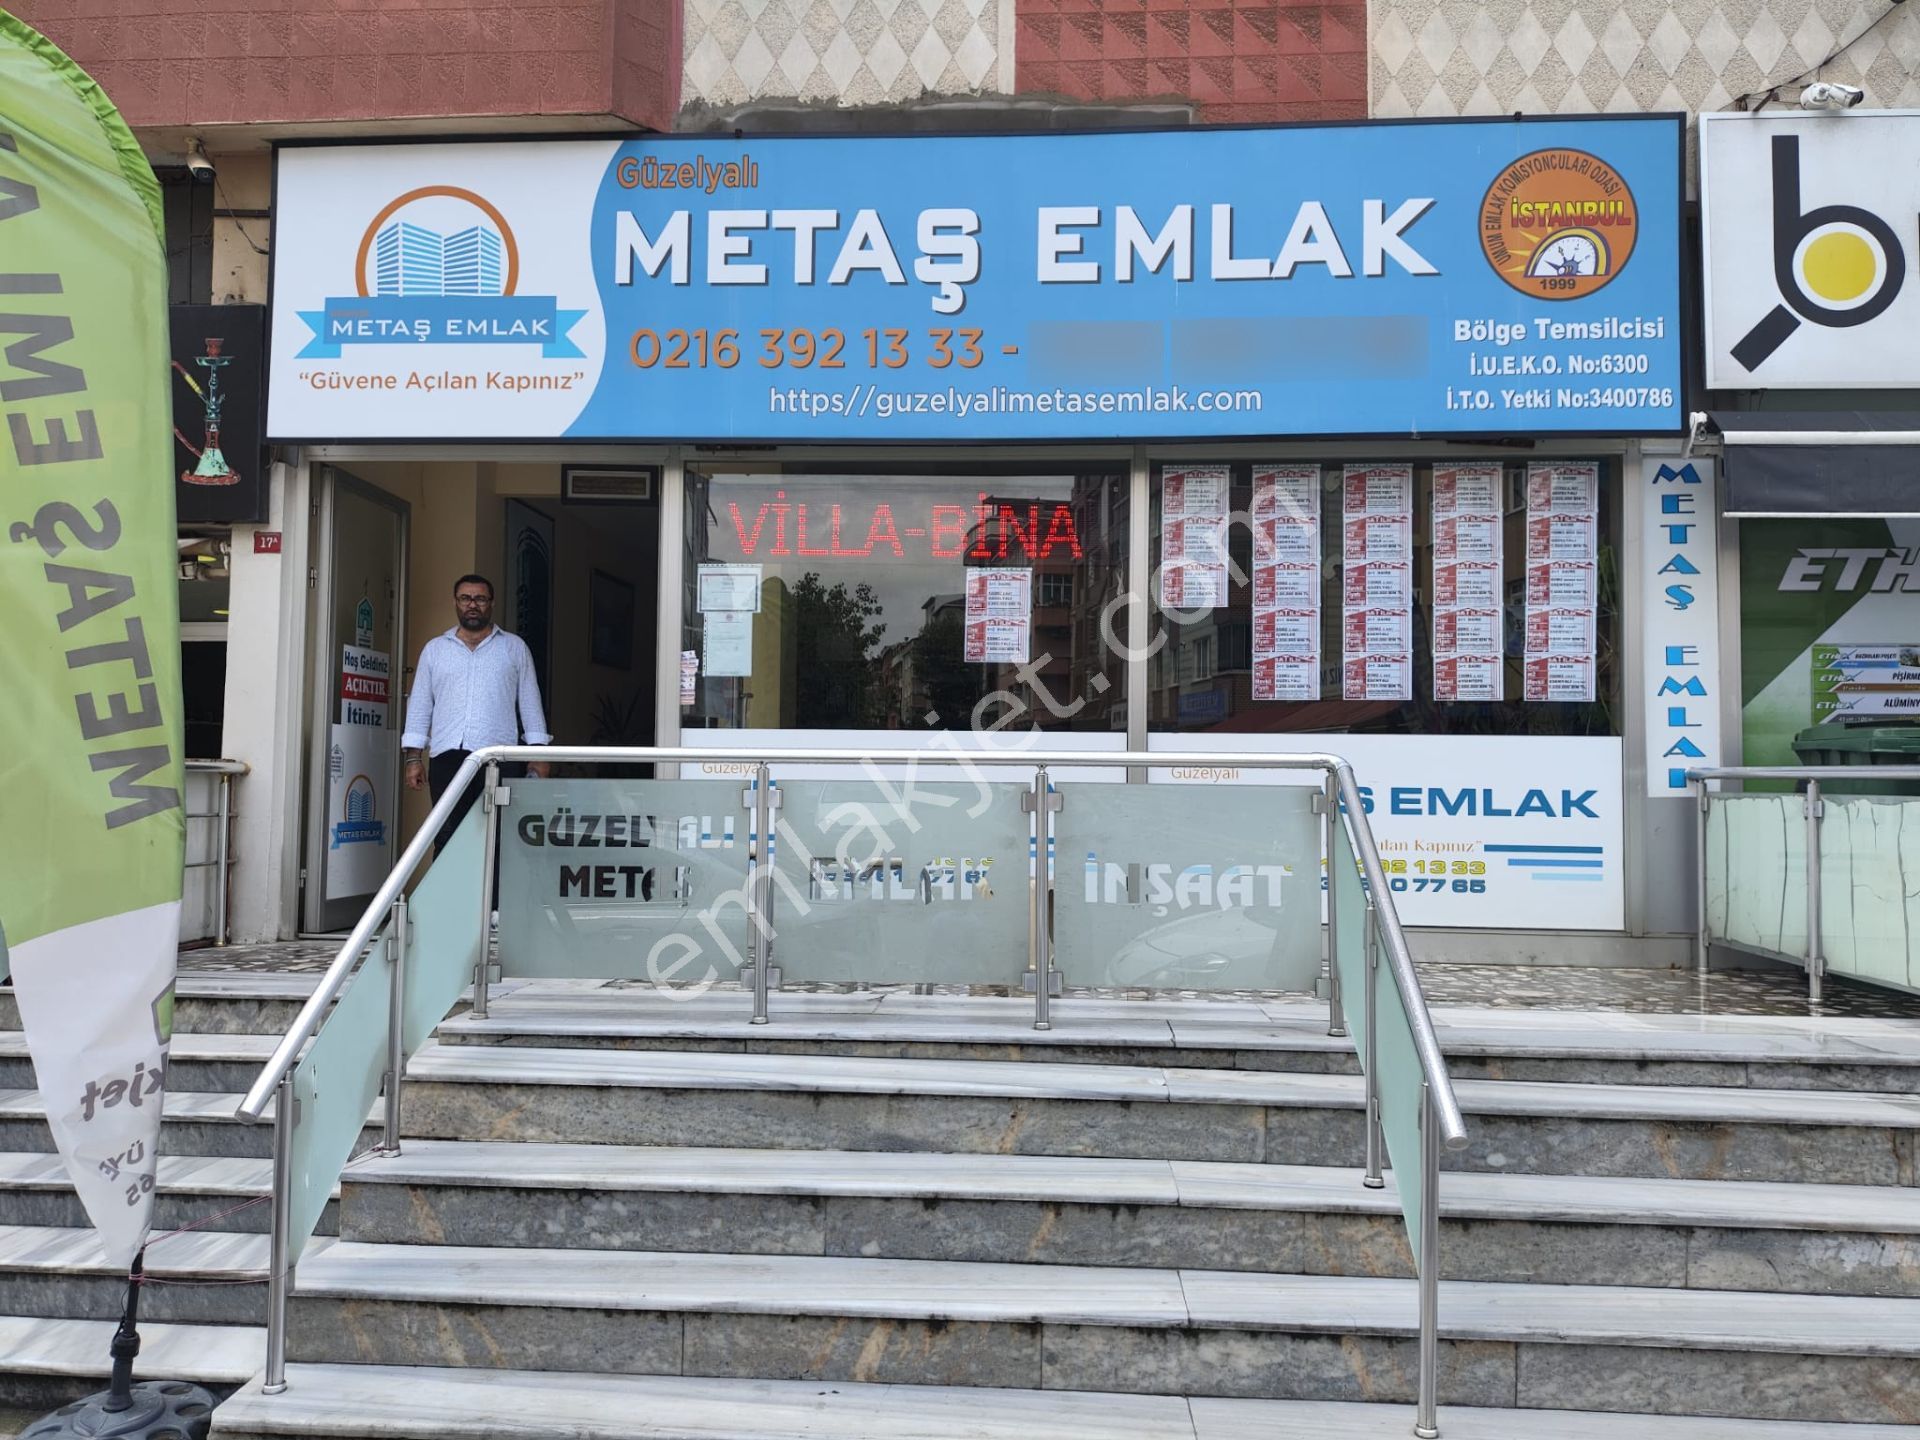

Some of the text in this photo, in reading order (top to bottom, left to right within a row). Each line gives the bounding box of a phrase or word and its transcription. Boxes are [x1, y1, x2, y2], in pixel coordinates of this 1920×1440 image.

[616, 155, 758, 194] Güzelyalı
[1511, 196, 1631, 228] İSTANBUL
[615, 198, 1442, 315] METAŞ EMLAK
[1540, 278, 1577, 290] 1999
[332, 319, 550, 342] METAŞ EMLAK
[1454, 316, 1665, 345] Bölge Temsilcisi
[629, 328, 741, 369] 0216
[758, 328, 846, 369] 392
[863, 328, 910, 369] 13
[927, 328, 985, 369] 33
[1568, 354, 1649, 375] No:6300
[406, 371, 478, 392] Açılan
[769, 384, 1263, 417] https//guzelyalimetasemlak.com
[1501, 389, 1551, 409] Yetki
[1557, 388, 1674, 409] No:3400786
[728, 490, 1083, 560] VİLLA-BİNA
[1652, 463, 1702, 611] METAŞ
[344, 652, 388, 673] Hoş Geldiniz
[345, 678, 386, 696] AÇIKTIR
[347, 703, 382, 727] İtiniz
[1390, 787, 1600, 818] EMLAK
[1414, 860, 1447, 875] 13
[1451, 860, 1486, 875] 33
[1085, 852, 1294, 917] İNŞAAT
[1413, 878, 1447, 893] 77
[1452, 879, 1486, 893] 65
